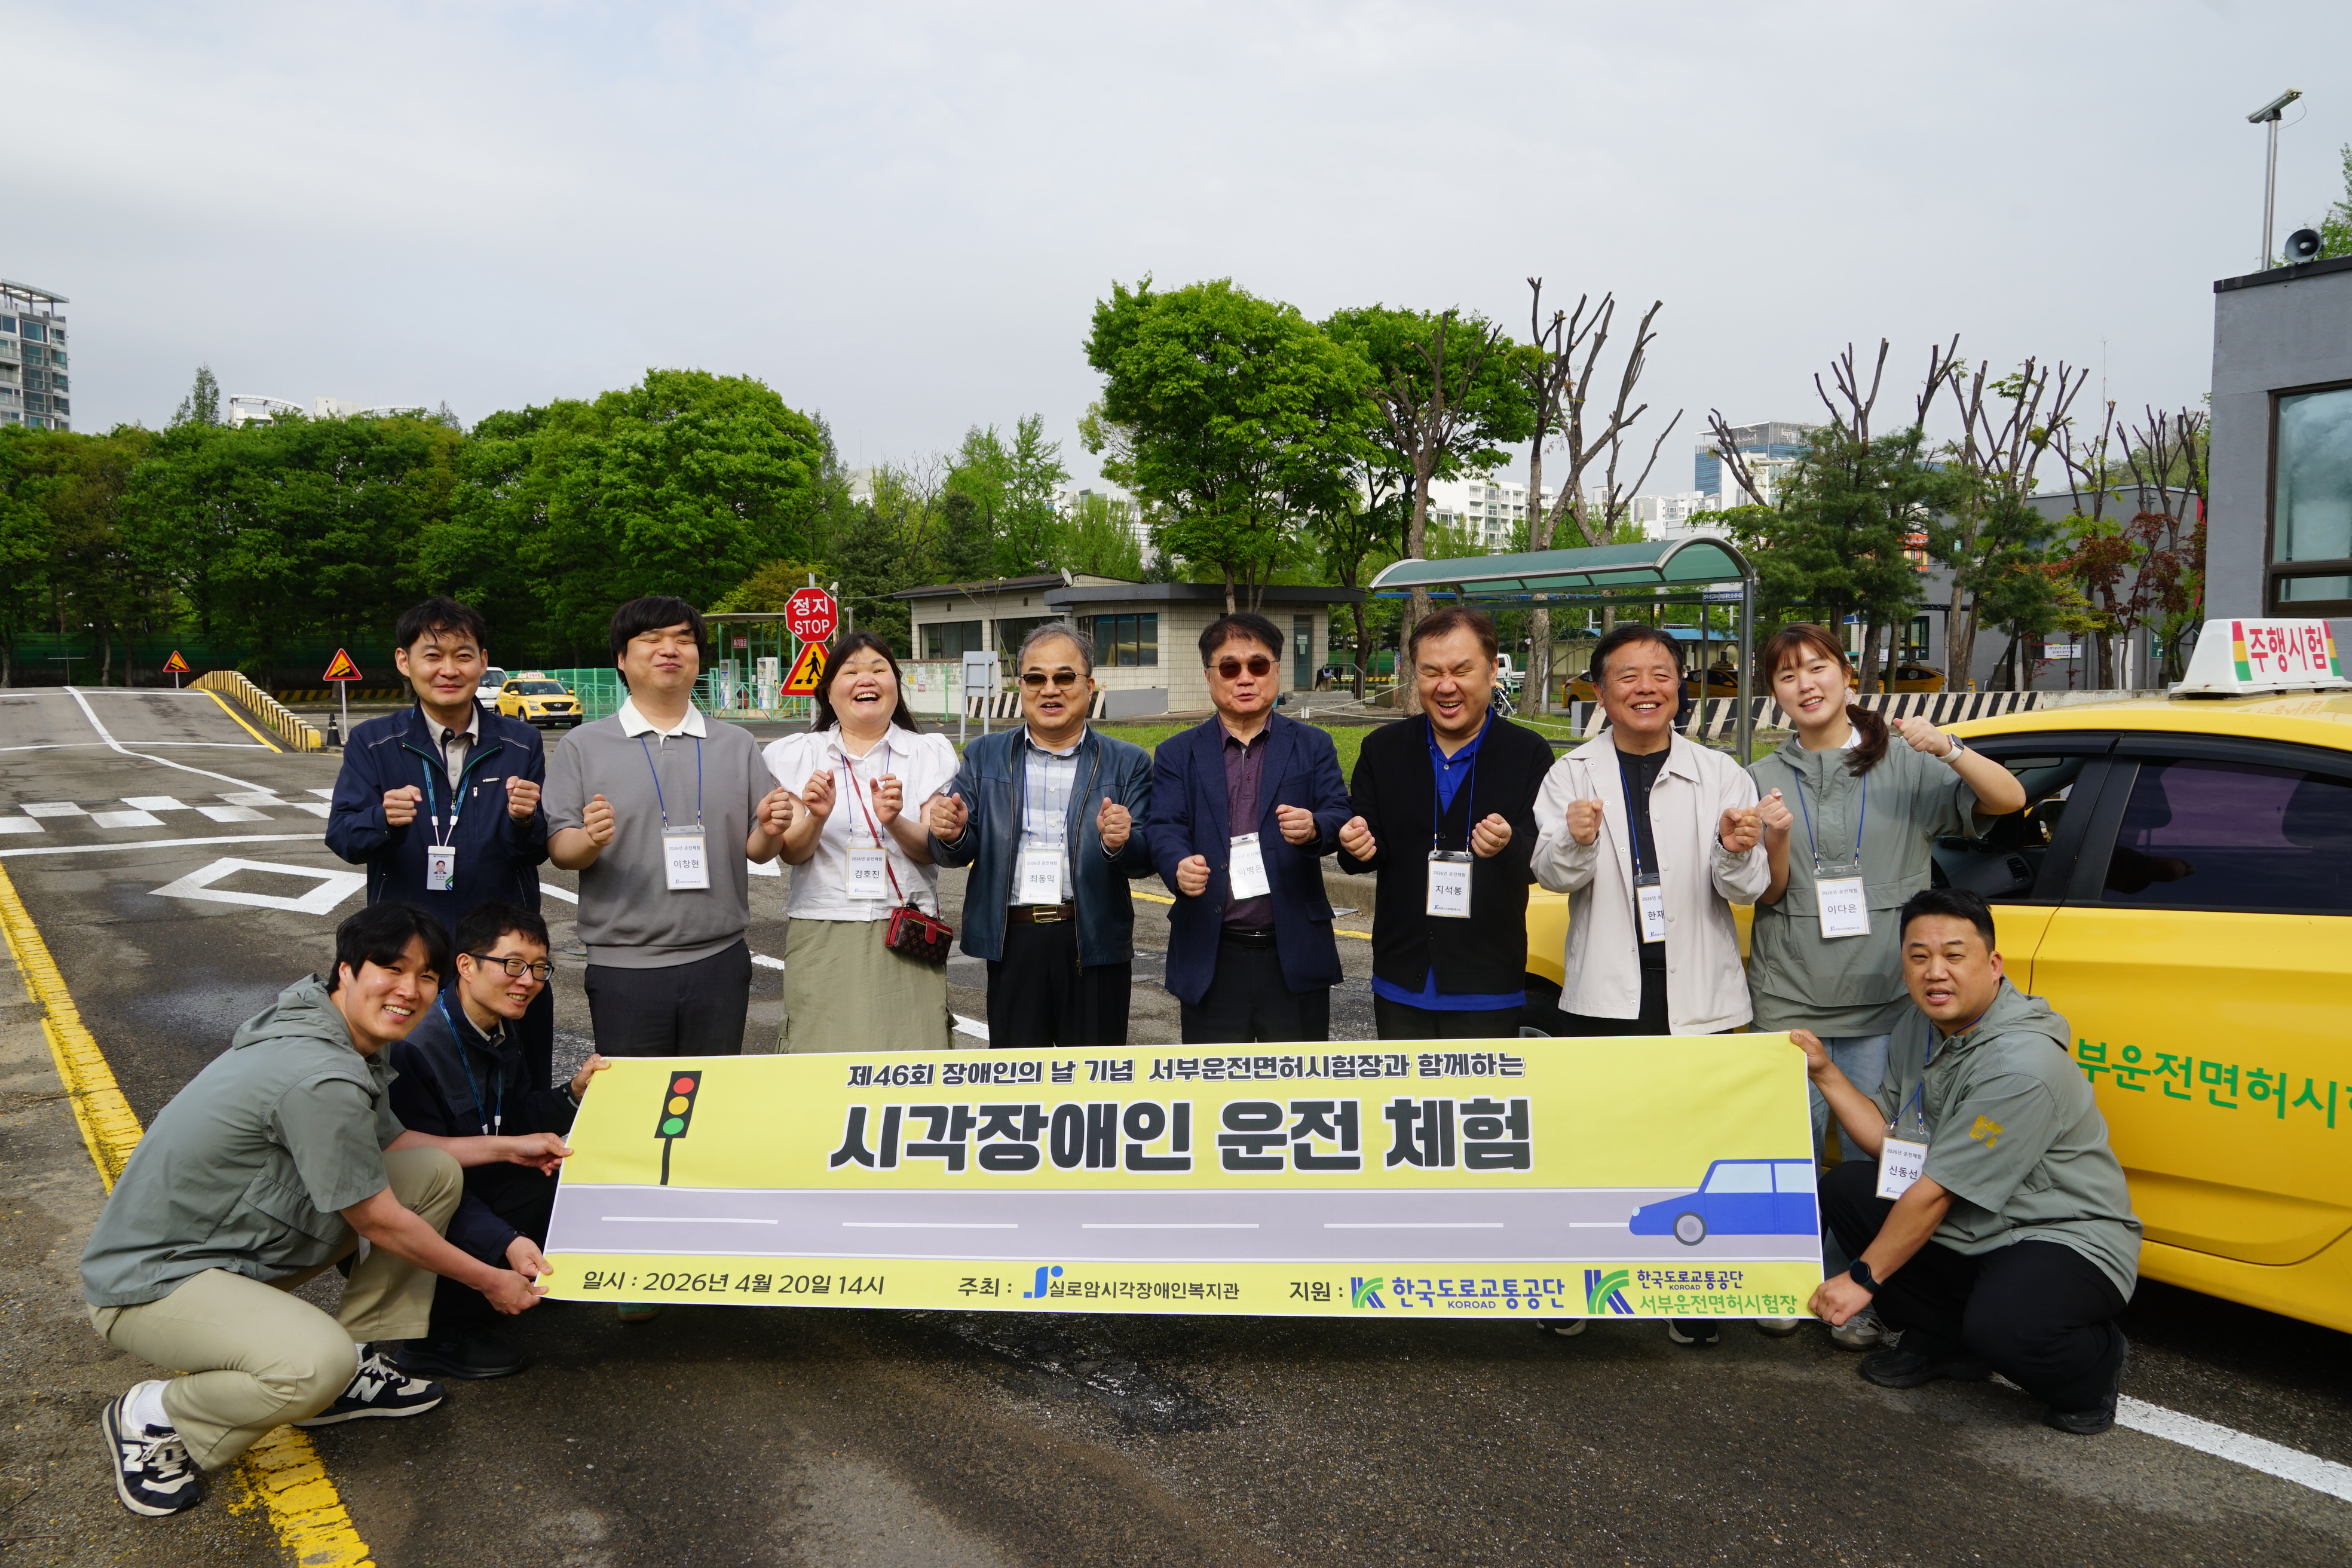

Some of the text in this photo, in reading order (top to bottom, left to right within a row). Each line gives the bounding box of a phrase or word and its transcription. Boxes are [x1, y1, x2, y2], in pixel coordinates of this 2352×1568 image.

[793, 596, 829, 616] 정지
[795, 619, 829, 635] STOP
[2249, 626, 2327, 672] 주행시험
[673, 860, 699, 868] 이창현
[1238, 865, 1263, 876] 이병돈
[855, 870, 879, 878] 김호진
[1030, 875, 1054, 883] 최동익
[1435, 886, 1462, 896] 지석봉
[1827, 904, 1857, 914] 이다은
[848, 1054, 1524, 1085] 제46회 장애인의 날 기념 서부운전면허시험장과 함께하는
[2076, 1038, 2352, 1129] 부운전면허시
[831, 1099, 1530, 1171] 시각장애인 운전 체험
[1889, 1165, 1918, 1180] 신동선
[583, 1272, 624, 1289] 일시
[643, 1273, 728, 1291] 2026년
[735, 1275, 771, 1292] 4월
[779, 1276, 831, 1294] 20일
[840, 1276, 884, 1294] 14시
[958, 1278, 999, 1296] 주최
[1637, 1270, 1743, 1290] 한국도로교통공단
[1050, 1281, 1239, 1299] 실로암시각장애인복지관
[1290, 1282, 1330, 1301] 지원
[1392, 1277, 1565, 1309] 한국도로교통공단
[1640, 1294, 1797, 1315] 서부운전면허시험장
